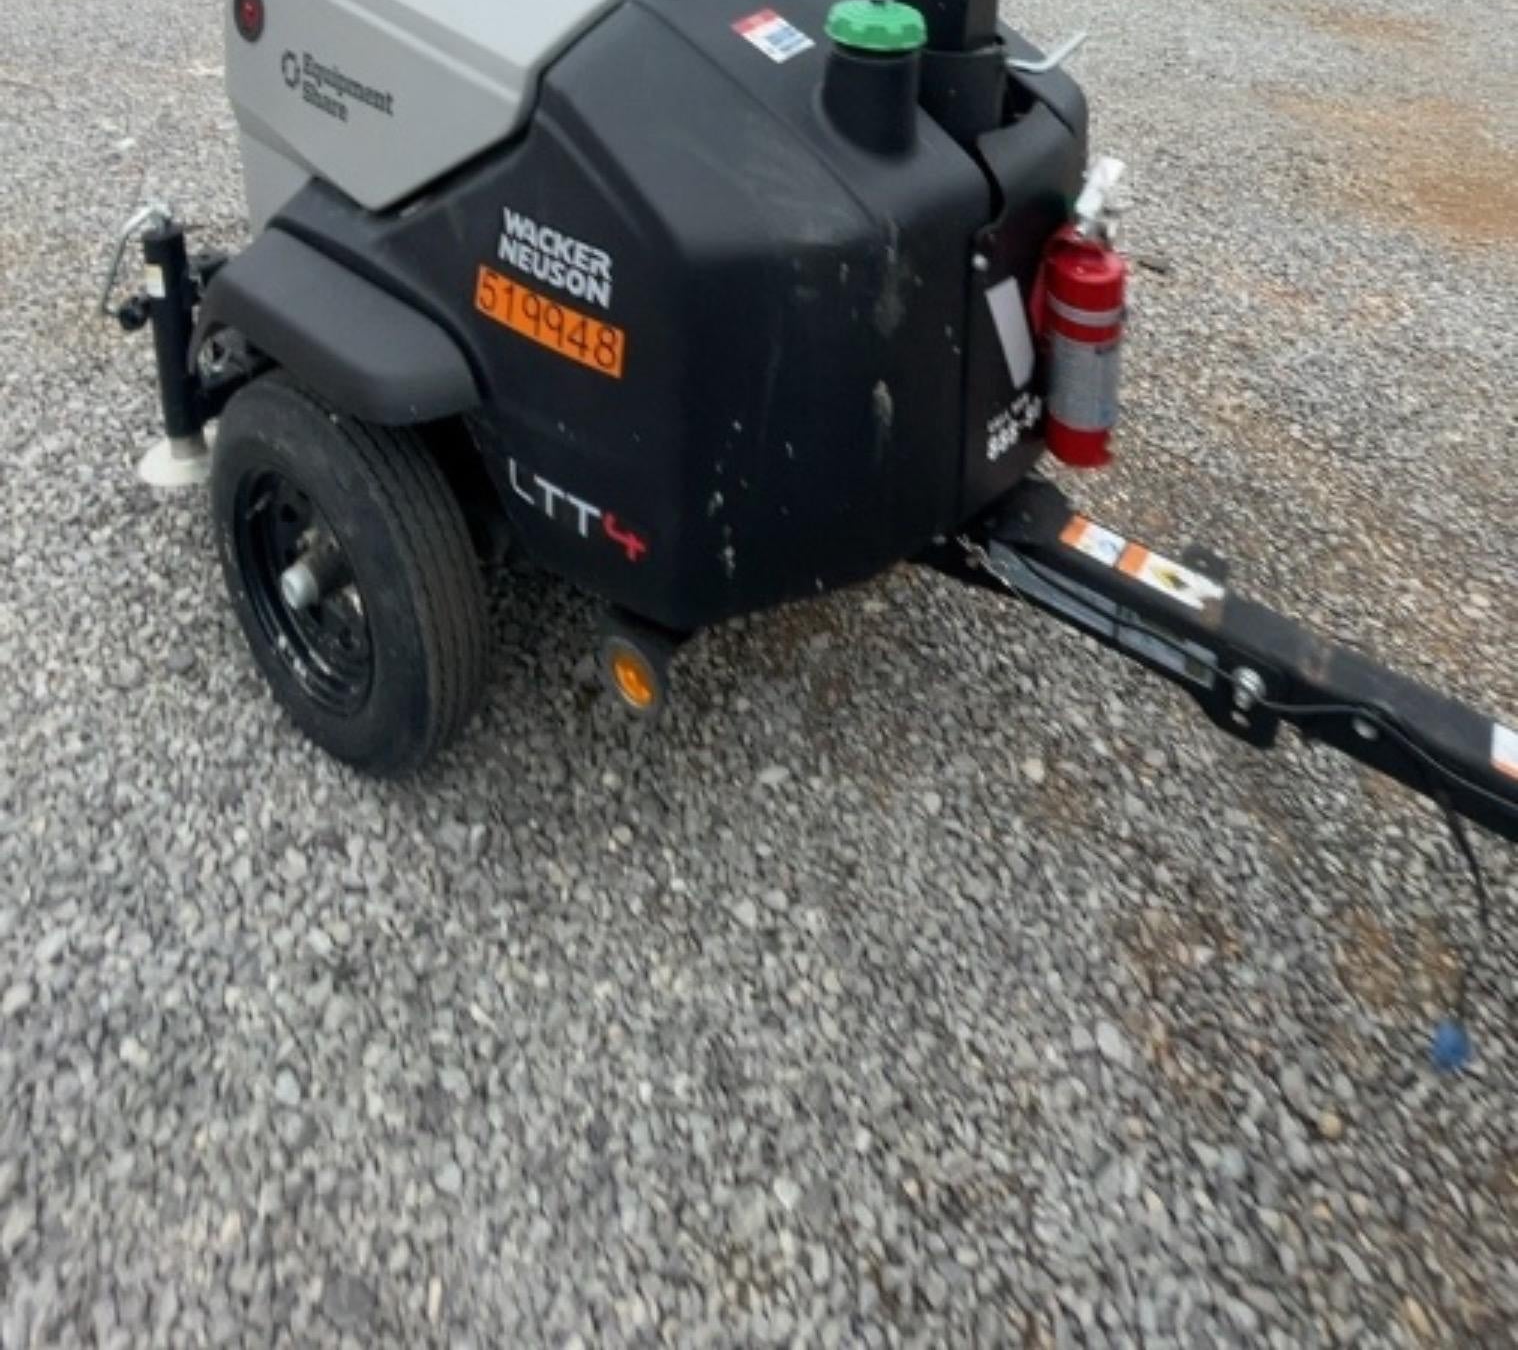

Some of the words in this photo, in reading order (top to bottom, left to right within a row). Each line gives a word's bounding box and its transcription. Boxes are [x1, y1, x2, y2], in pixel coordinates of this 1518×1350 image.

[302, 51, 394, 117] Equipment
[302, 80, 348, 123] Share
[498, 233, 612, 310] NEUSON
[503, 206, 612, 281] WACKER
[479, 270, 619, 368] 519948
[509, 457, 647, 562] LTT4
